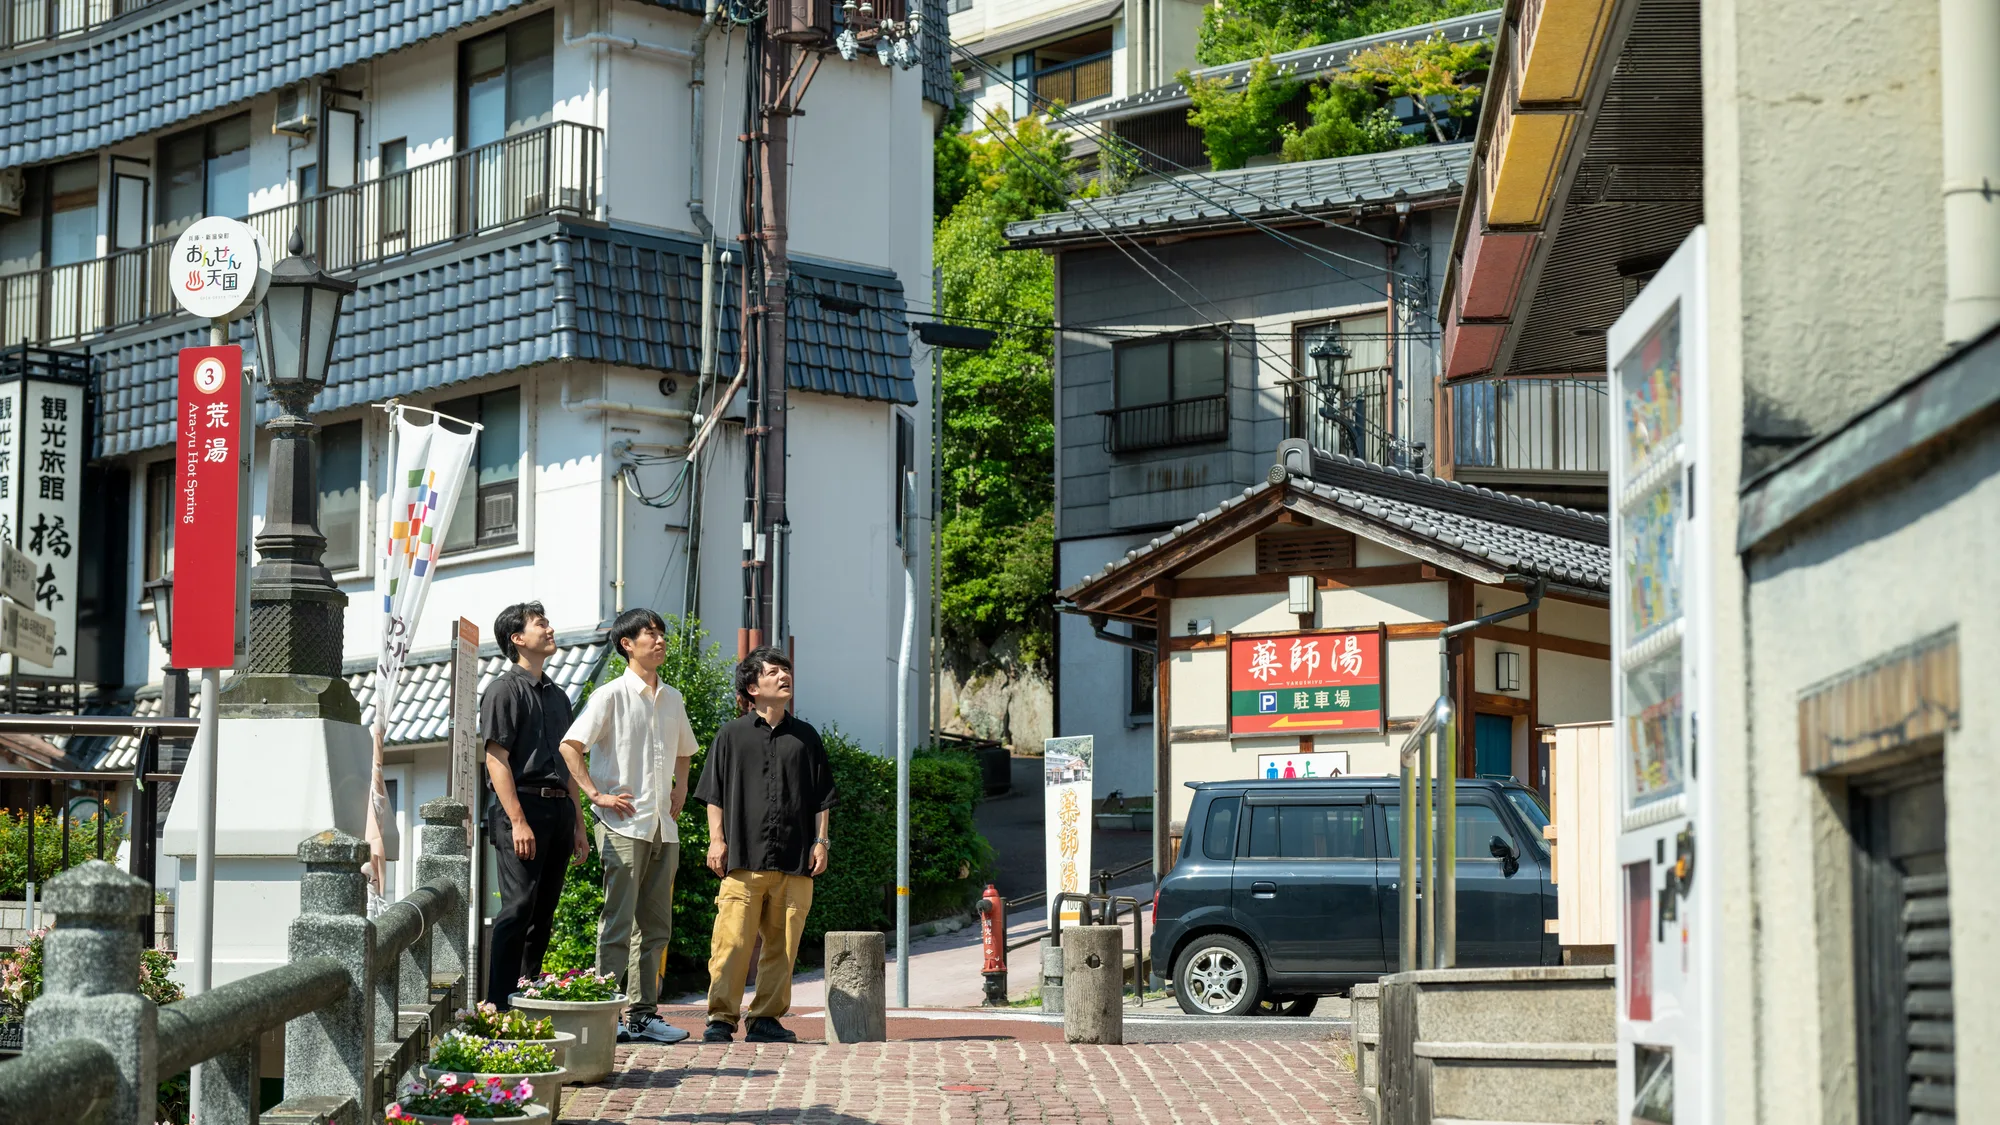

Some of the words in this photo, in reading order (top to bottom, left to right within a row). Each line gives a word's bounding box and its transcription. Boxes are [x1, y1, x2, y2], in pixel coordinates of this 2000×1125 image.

[186, 244, 242, 271] おんせん
[206, 269, 238, 291] 天国
[204, 368, 215, 386] 3
[183, 402, 200, 449] Ara-yu
[204, 401, 230, 463] 荒湯
[38, 395, 68, 501] 観光旅館
[187, 451, 199, 477] Hot
[183, 479, 198, 524] Spring
[29, 512, 72, 657] 橋本
[1262, 695, 1275, 711] P
[1293, 690, 1350, 710] 駐車場
